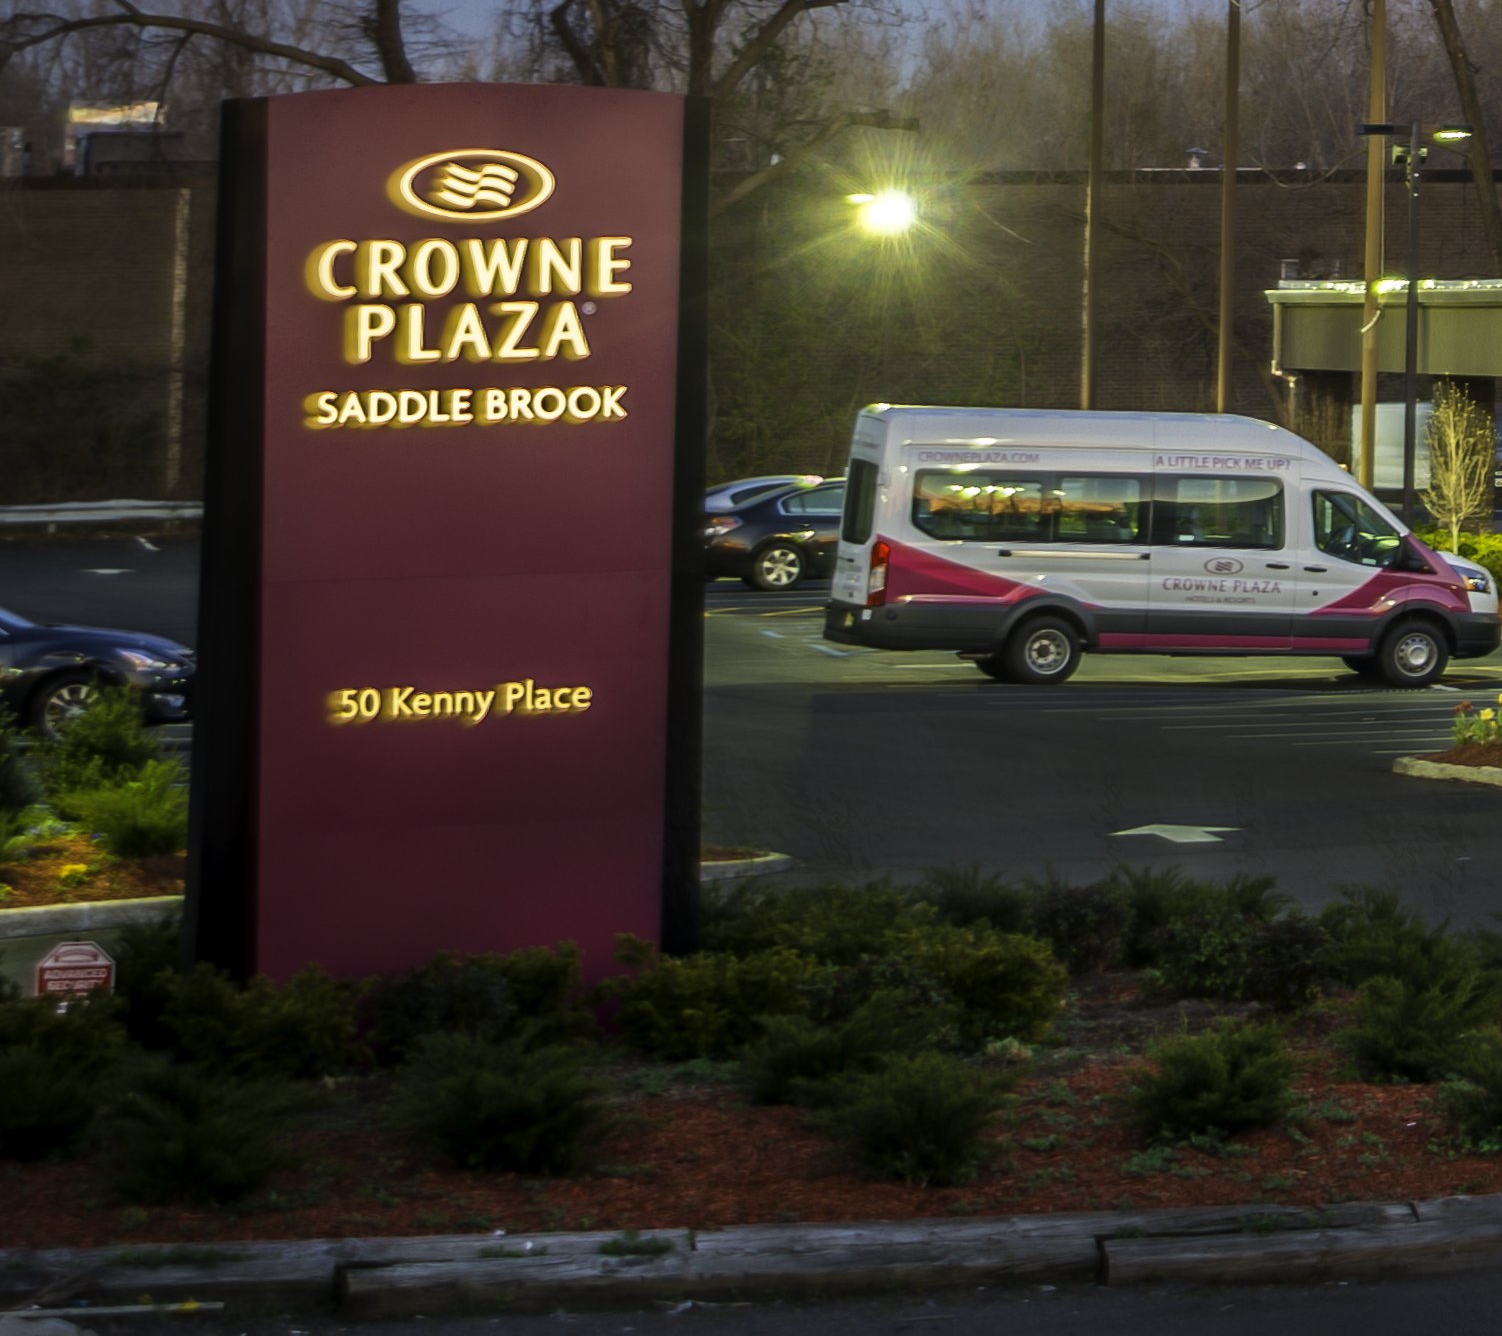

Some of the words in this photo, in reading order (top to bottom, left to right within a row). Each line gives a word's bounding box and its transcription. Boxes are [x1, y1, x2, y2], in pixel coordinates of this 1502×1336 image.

[306, 237, 633, 299] CROWNE
[347, 301, 590, 363] PLAZA
[305, 387, 473, 425] SADDLE
[477, 385, 628, 423] BROOK
[918, 451, 1040, 464] CROWNEPLAZA.COM
[1155, 456, 1165, 467] A
[1167, 456, 1210, 468] LITTLE
[1212, 457, 1241, 469] PICK
[1244, 458, 1263, 470] ME
[1266, 459, 1291, 471] UP?
[1162, 577, 1227, 593] CROWNE
[1232, 579, 1281, 594] PLAZA
[328, 688, 381, 723] 50
[382, 686, 495, 726] Kenny
[496, 678, 592, 719] Place
